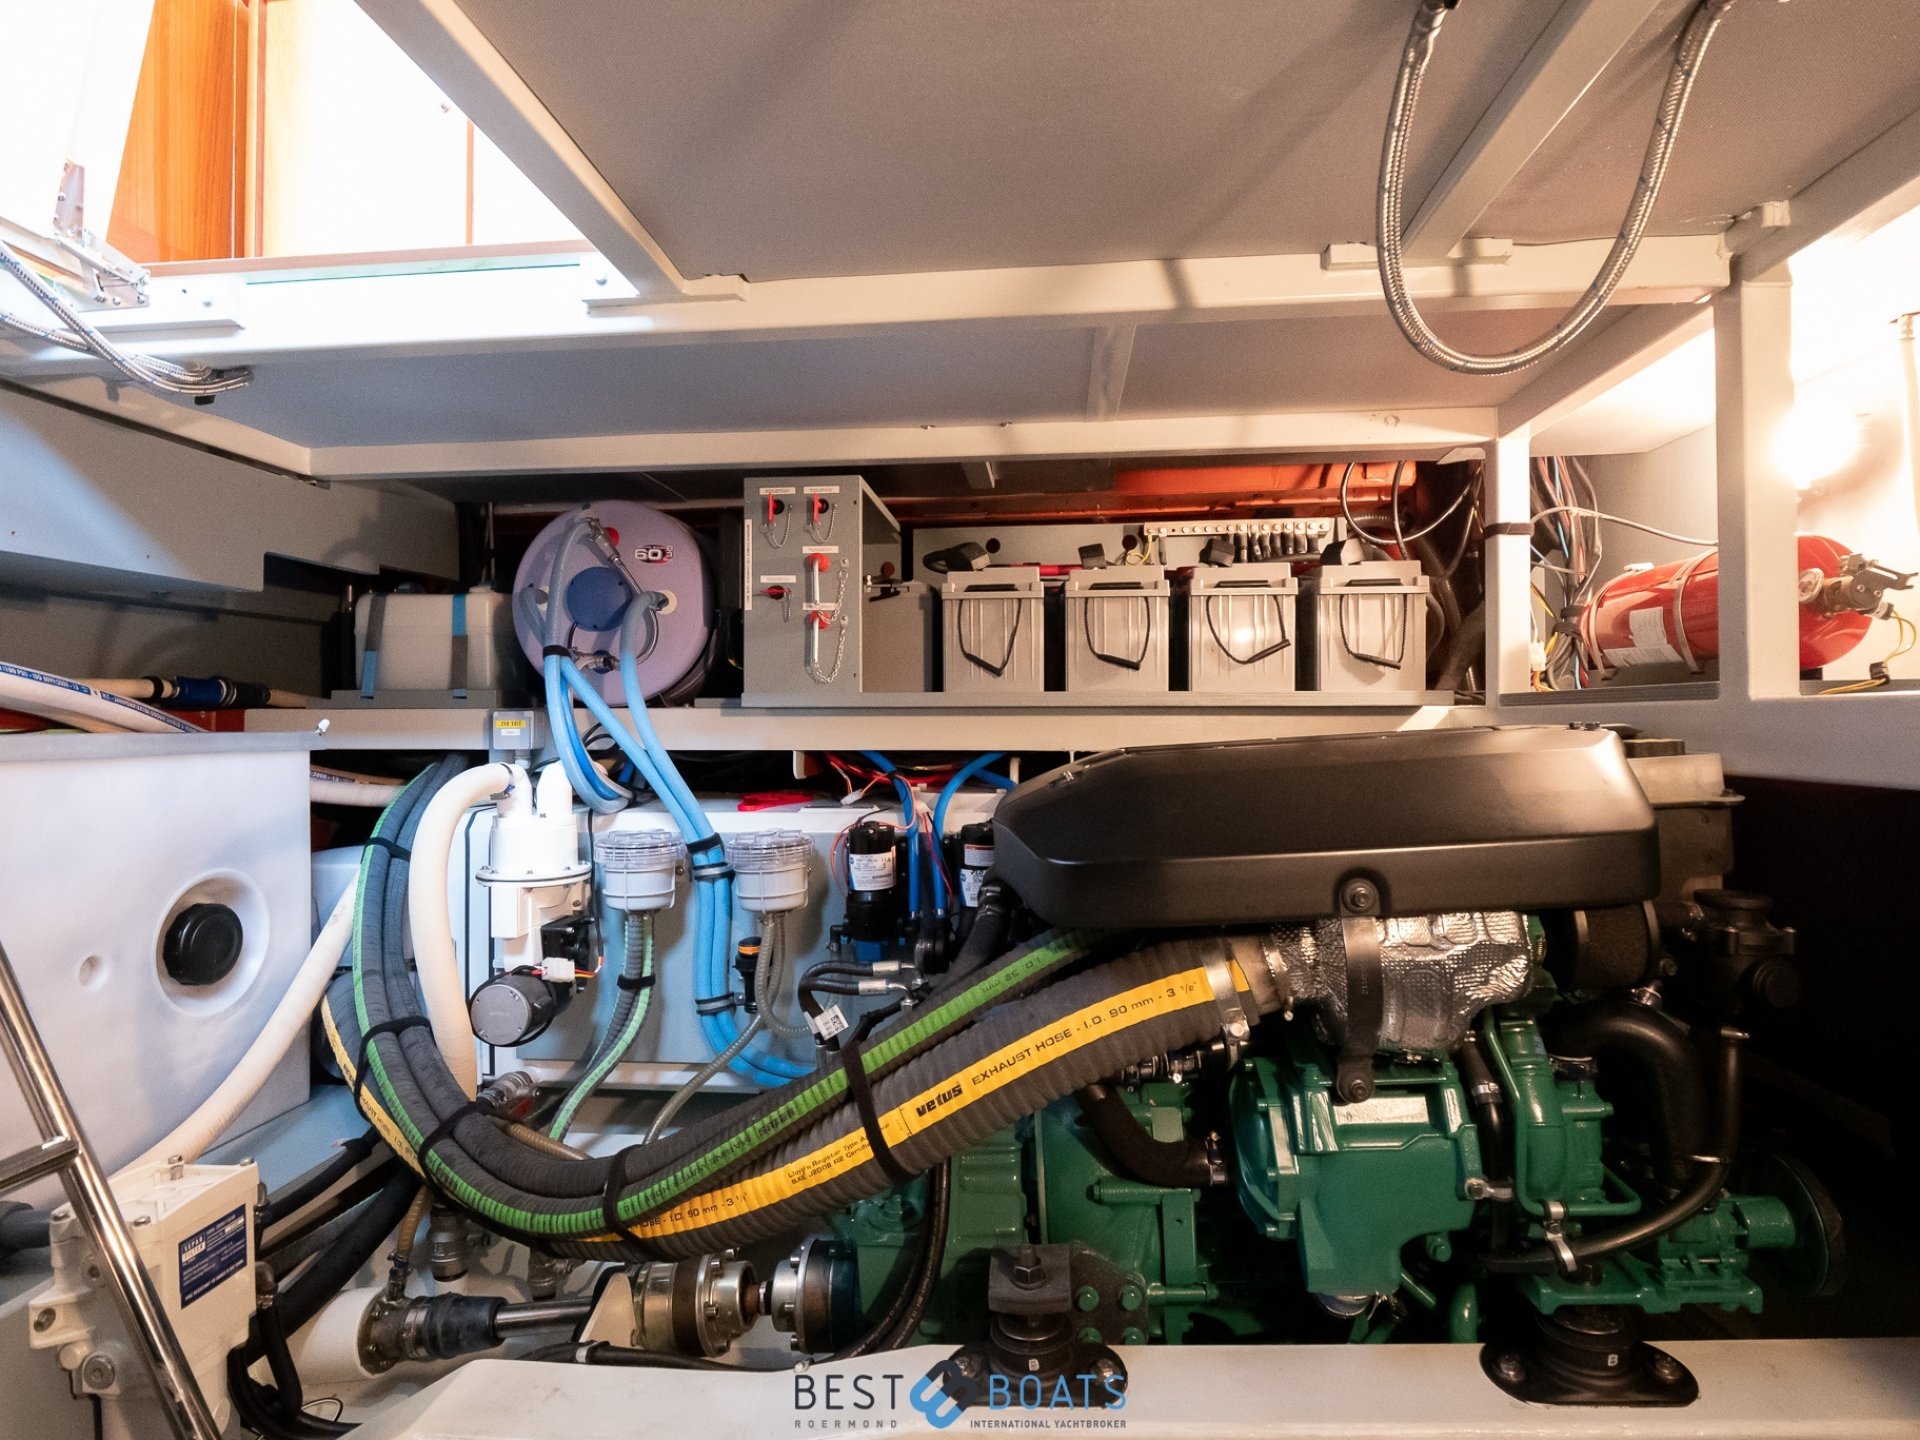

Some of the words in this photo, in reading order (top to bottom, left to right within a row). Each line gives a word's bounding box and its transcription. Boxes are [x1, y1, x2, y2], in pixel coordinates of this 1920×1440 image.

[634, 548, 663, 561] 60
[915, 1083, 964, 1118] vetus
[971, 1047, 1033, 1086] EXHAUST
[1034, 1028, 1073, 1052] HOSE
[1109, 1005, 1128, 1019] 90
[1131, 997, 1155, 1011] mm
[702, 1204, 719, 1215] mm
[1607, 1353, 1619, 1367] B
